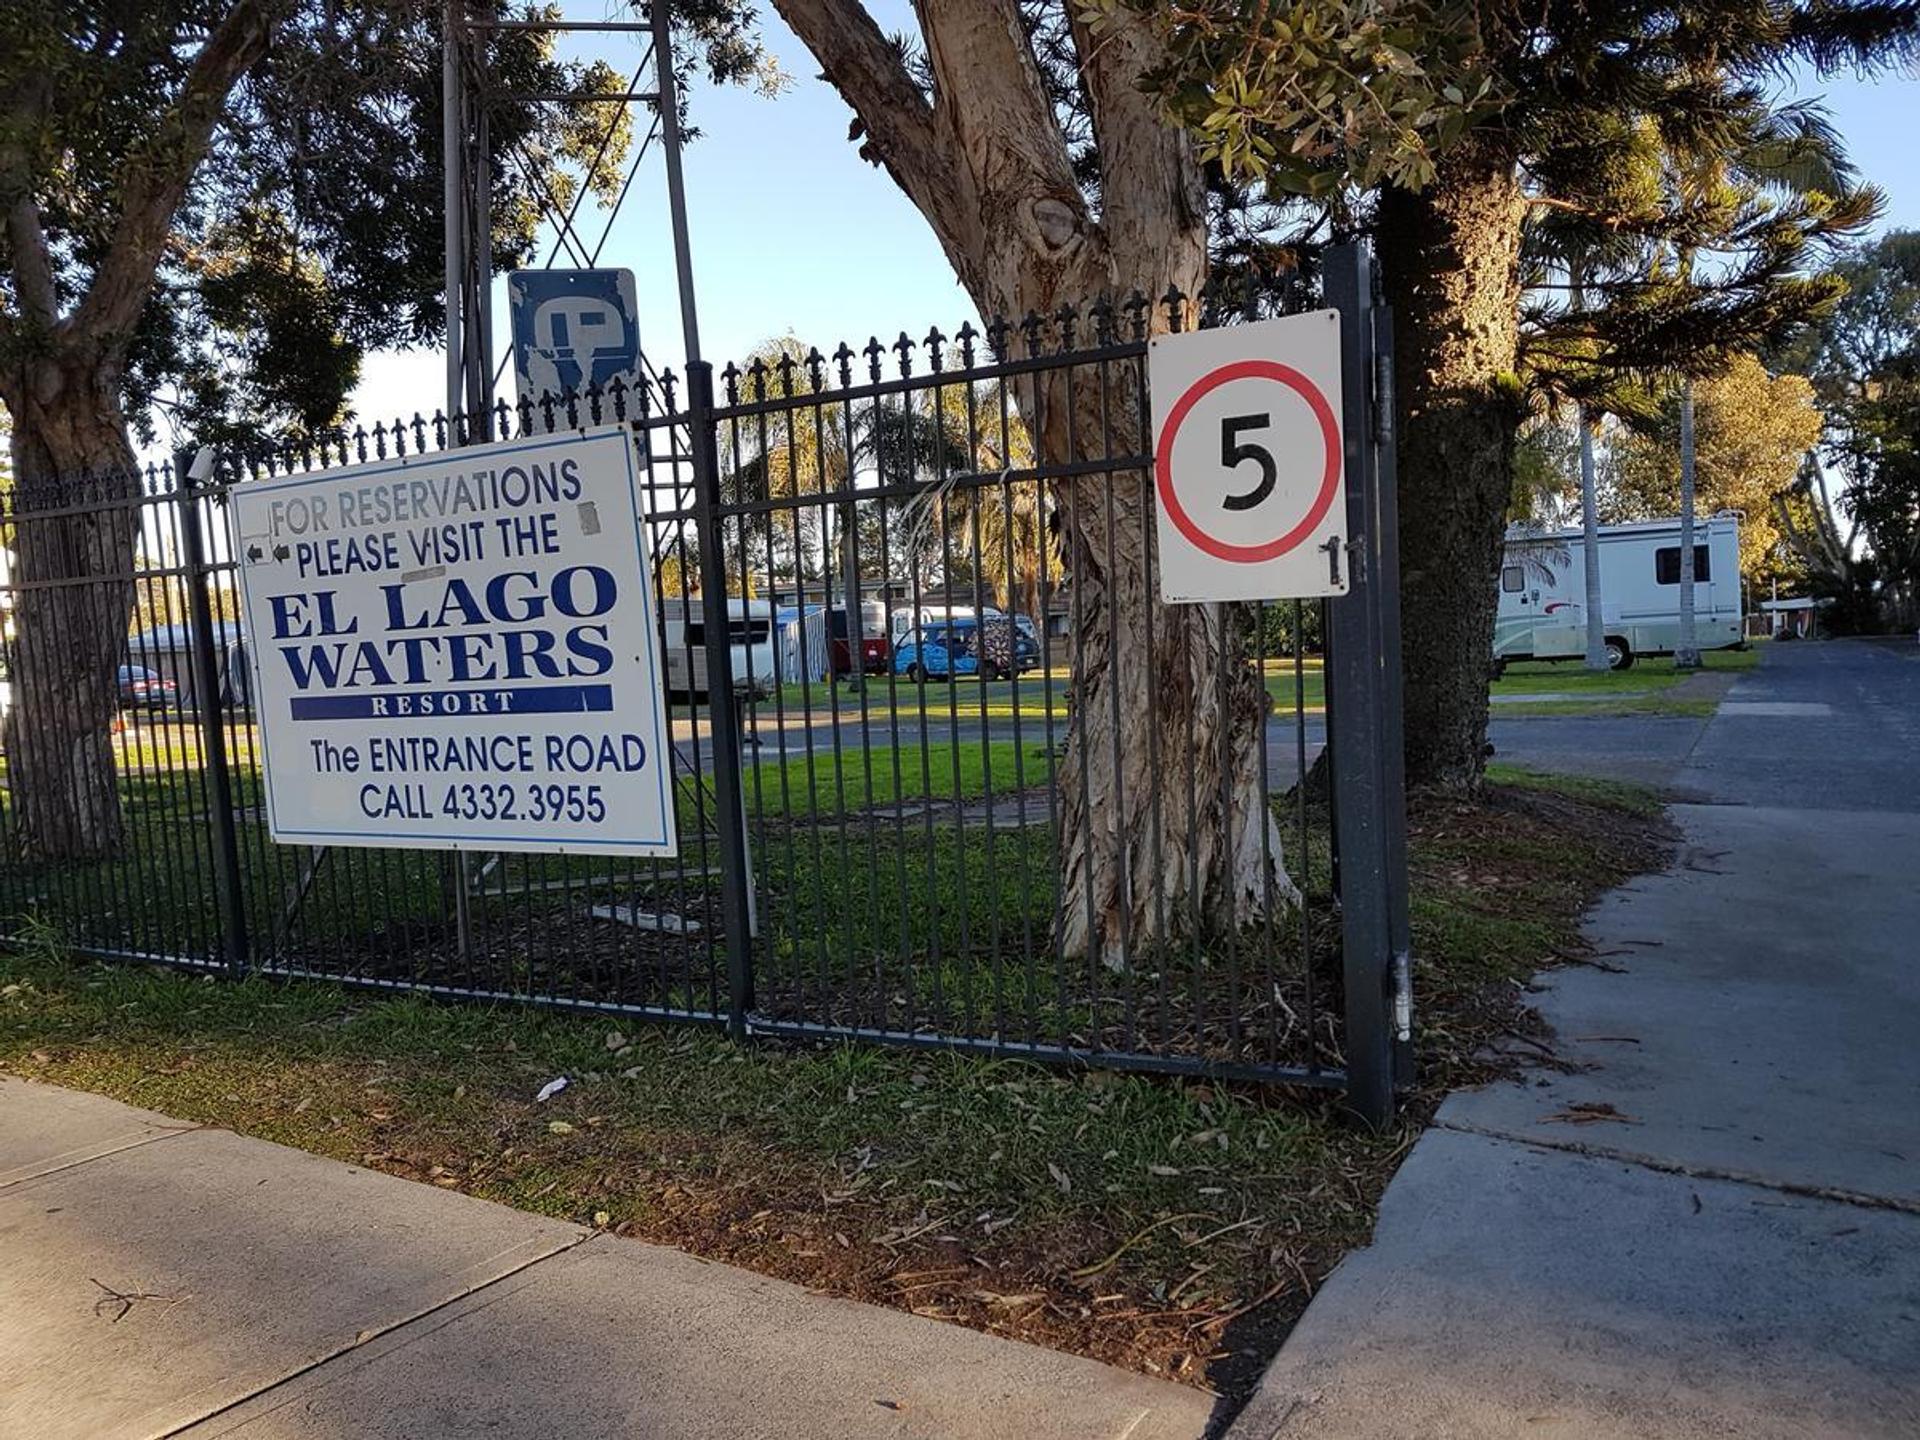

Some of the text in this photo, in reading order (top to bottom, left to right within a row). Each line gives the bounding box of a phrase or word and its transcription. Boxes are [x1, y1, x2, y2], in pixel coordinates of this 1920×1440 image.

[1220, 413, 1277, 511] 5
[271, 458, 582, 537] FOR RESERVATIONS
[297, 513, 560, 578] PLEASE VISIT THE
[267, 566, 617, 640] EL LAGO
[279, 625, 614, 690] WATERS
[371, 692, 514, 716] RESORT
[311, 734, 646, 773] The ENTRANCE ROAD
[360, 783, 606, 822] CALL 4332.3955
